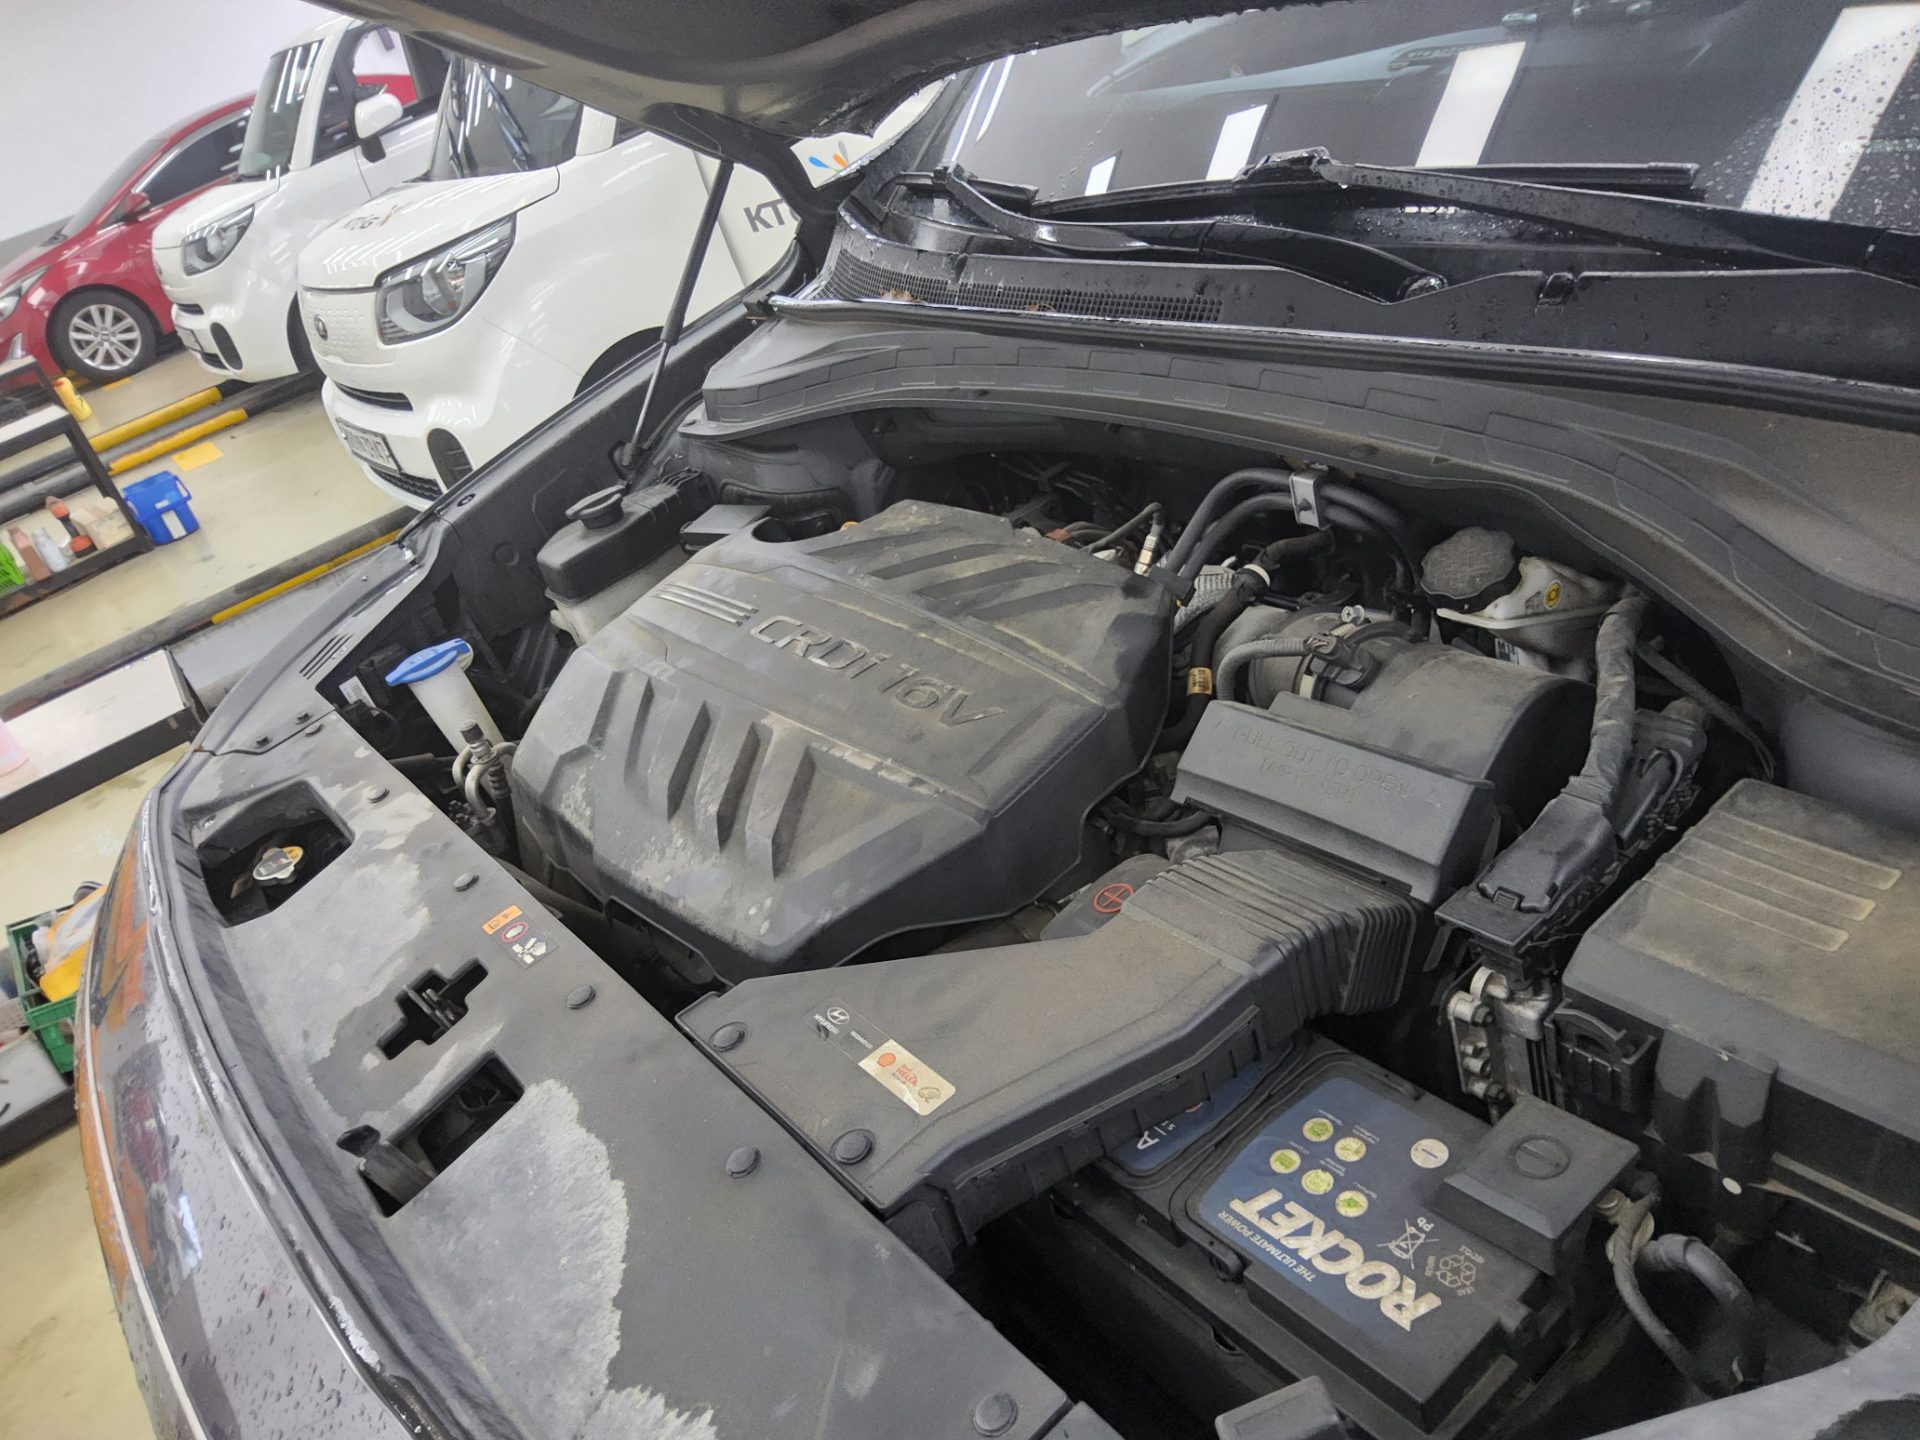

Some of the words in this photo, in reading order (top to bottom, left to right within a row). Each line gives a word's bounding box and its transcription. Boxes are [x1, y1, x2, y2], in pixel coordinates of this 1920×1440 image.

[743, 198, 800, 233] KT
[878, 663, 1005, 727] 16V
[1232, 725, 1277, 751] PULL
[1282, 738, 1320, 763] OUT
[1326, 752, 1353, 777] TO
[1355, 763, 1410, 798] OPEN
[1218, 1211, 1253, 1237] POWER
[1417, 1216, 1434, 1232] Pb
[1229, 1188, 1442, 1332] ROCKET
[1249, 1233, 1297, 1268] ULTIMATE
[1293, 1264, 1316, 1282] THE
